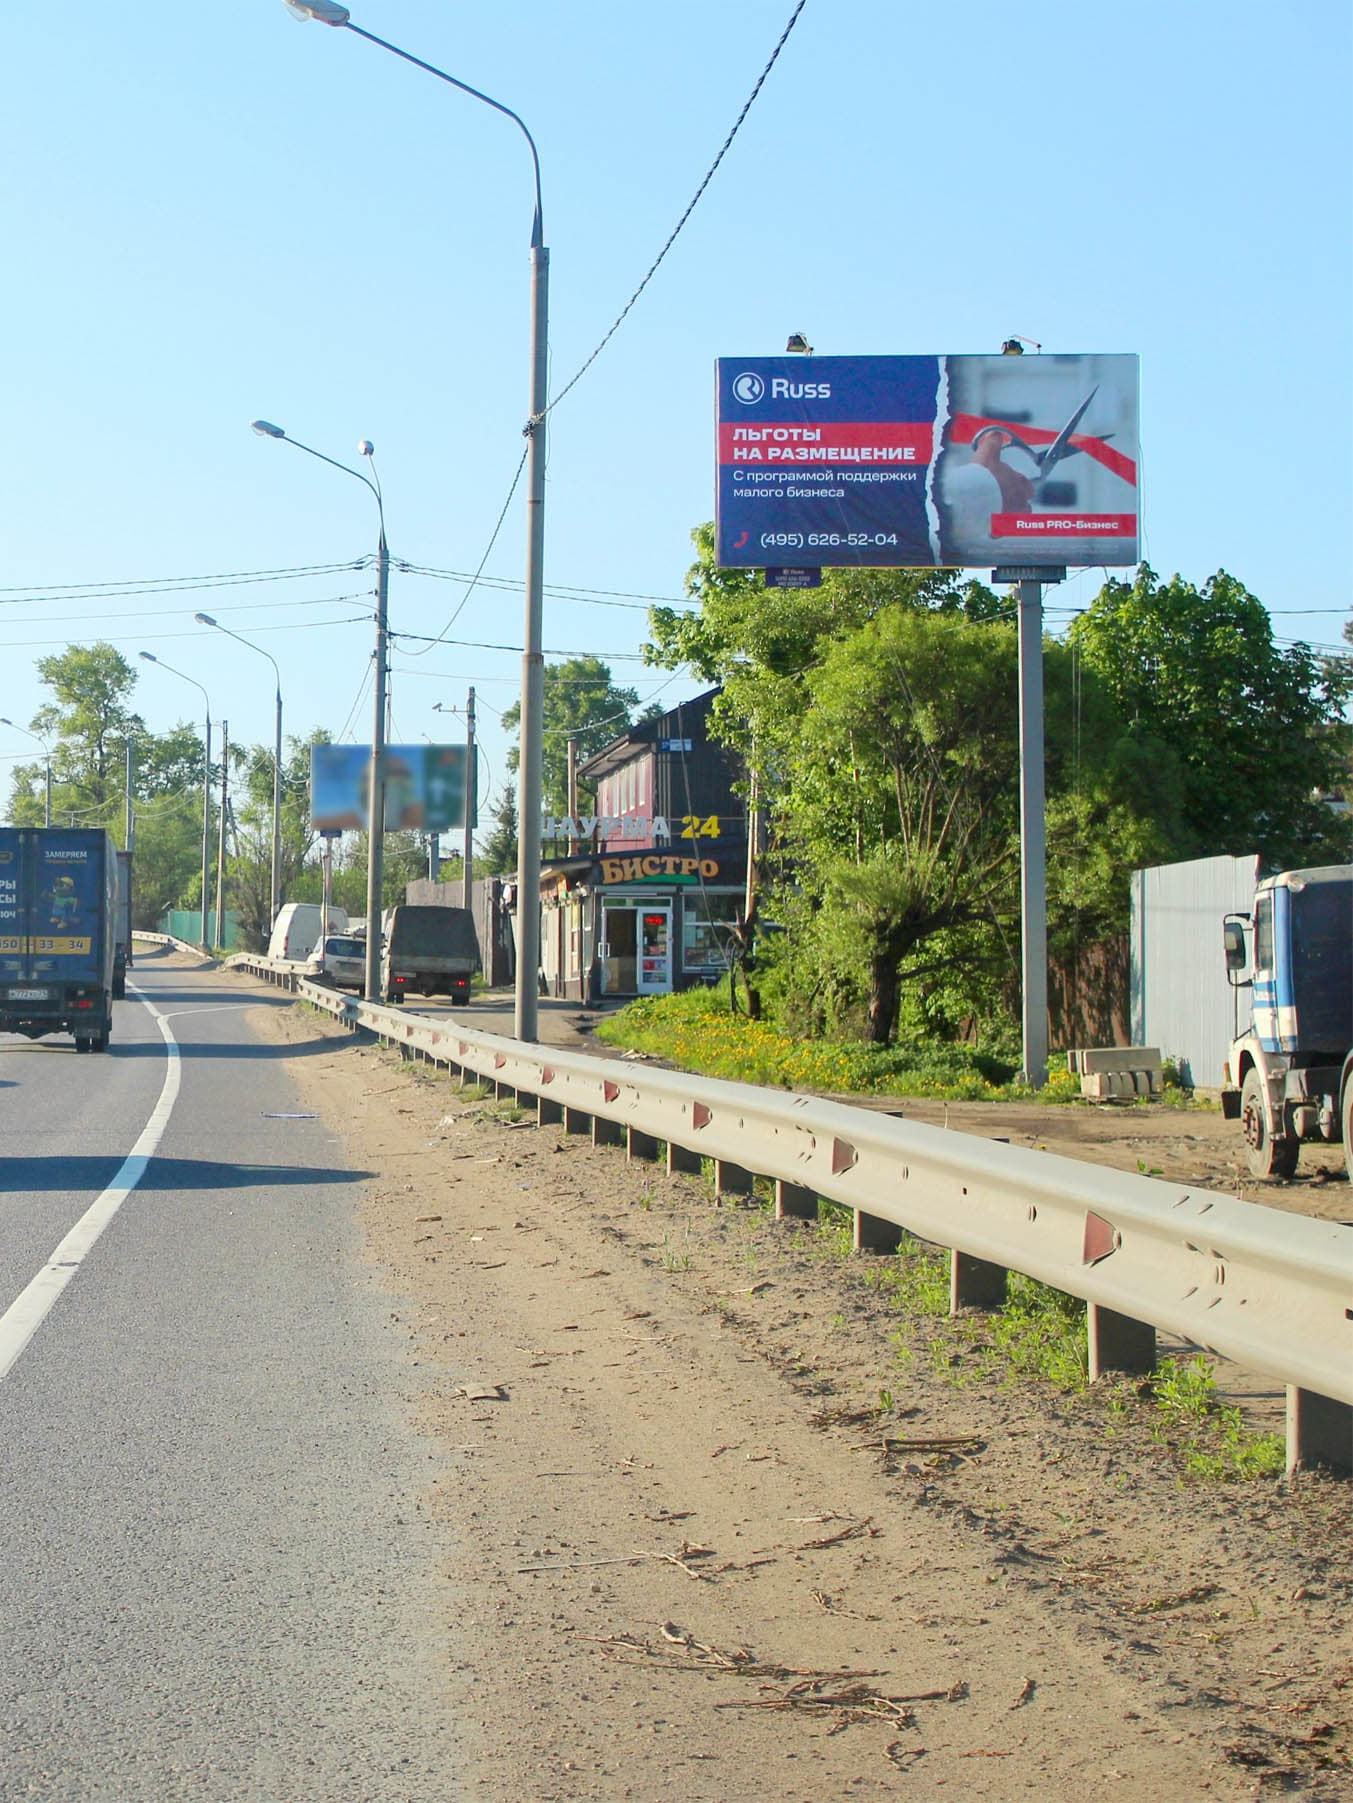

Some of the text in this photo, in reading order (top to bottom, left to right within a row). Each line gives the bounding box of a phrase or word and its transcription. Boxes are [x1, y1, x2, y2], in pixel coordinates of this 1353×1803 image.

[771, 378, 831, 399] Russ
[733, 428, 821, 441] ЛЬГОТЫ
[733, 447, 916, 462] НА РАЗМЕЩЕНИЕ
[733, 469, 917, 483] С программой поддержки
[733, 486, 845, 498] малого бизнеса
[1047, 520, 1119, 529] PRO-Бизнес
[760, 532, 898, 548] (495) 626-52-04
[681, 815, 721, 839] 24
[600, 856, 720, 884] БИСТРО
[40, 940, 54, 949] 33
